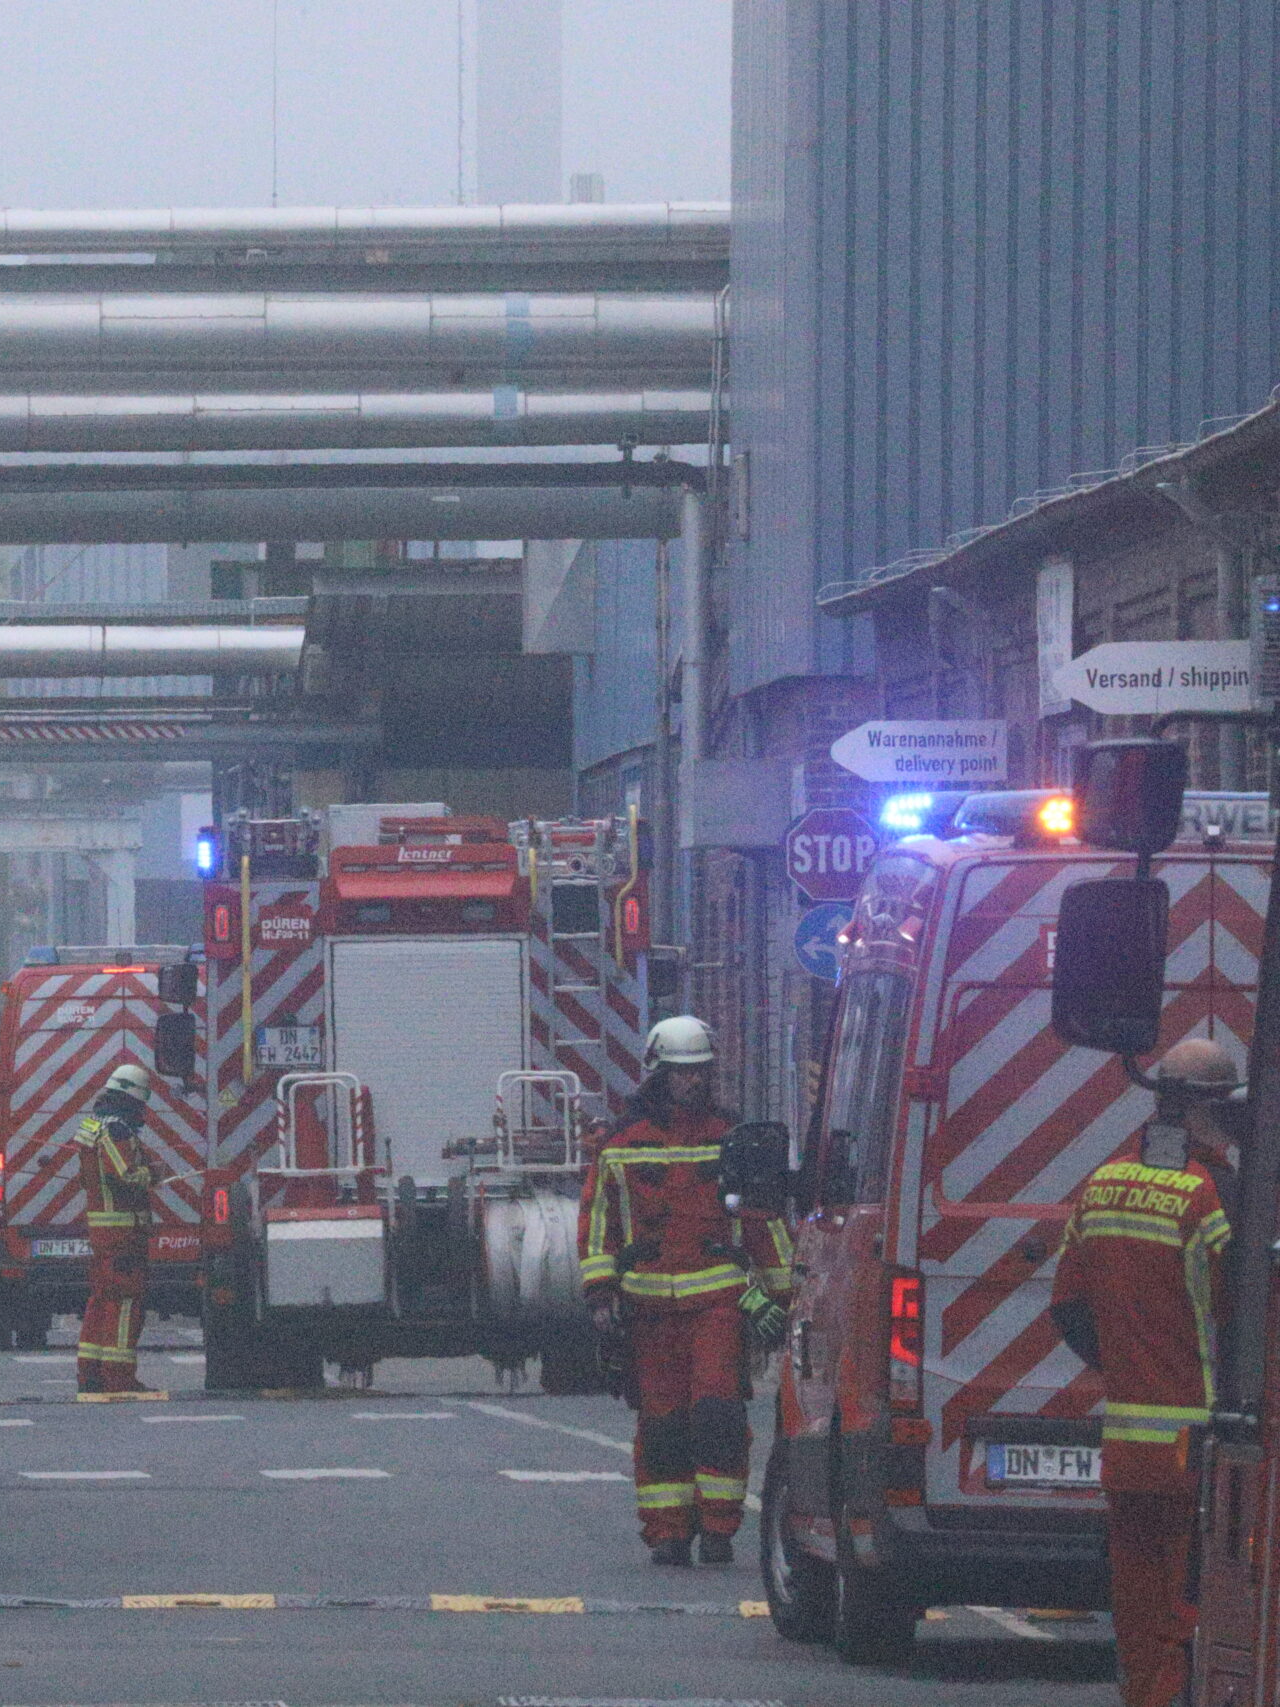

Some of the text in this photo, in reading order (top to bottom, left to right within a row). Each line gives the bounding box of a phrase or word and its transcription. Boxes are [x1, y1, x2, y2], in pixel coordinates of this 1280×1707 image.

[1086, 666, 1249, 691] Versand / shippin
[867, 729, 987, 749] Warenannahme
[894, 755, 998, 775] delivery point
[793, 833, 875, 874] STOP
[261, 915, 310, 929] DÜREN
[1090, 1161, 1204, 1192] EUERWEHR
[1124, 1185, 1192, 1217] DÜREN
[1006, 1447, 1092, 1478] DN FW
